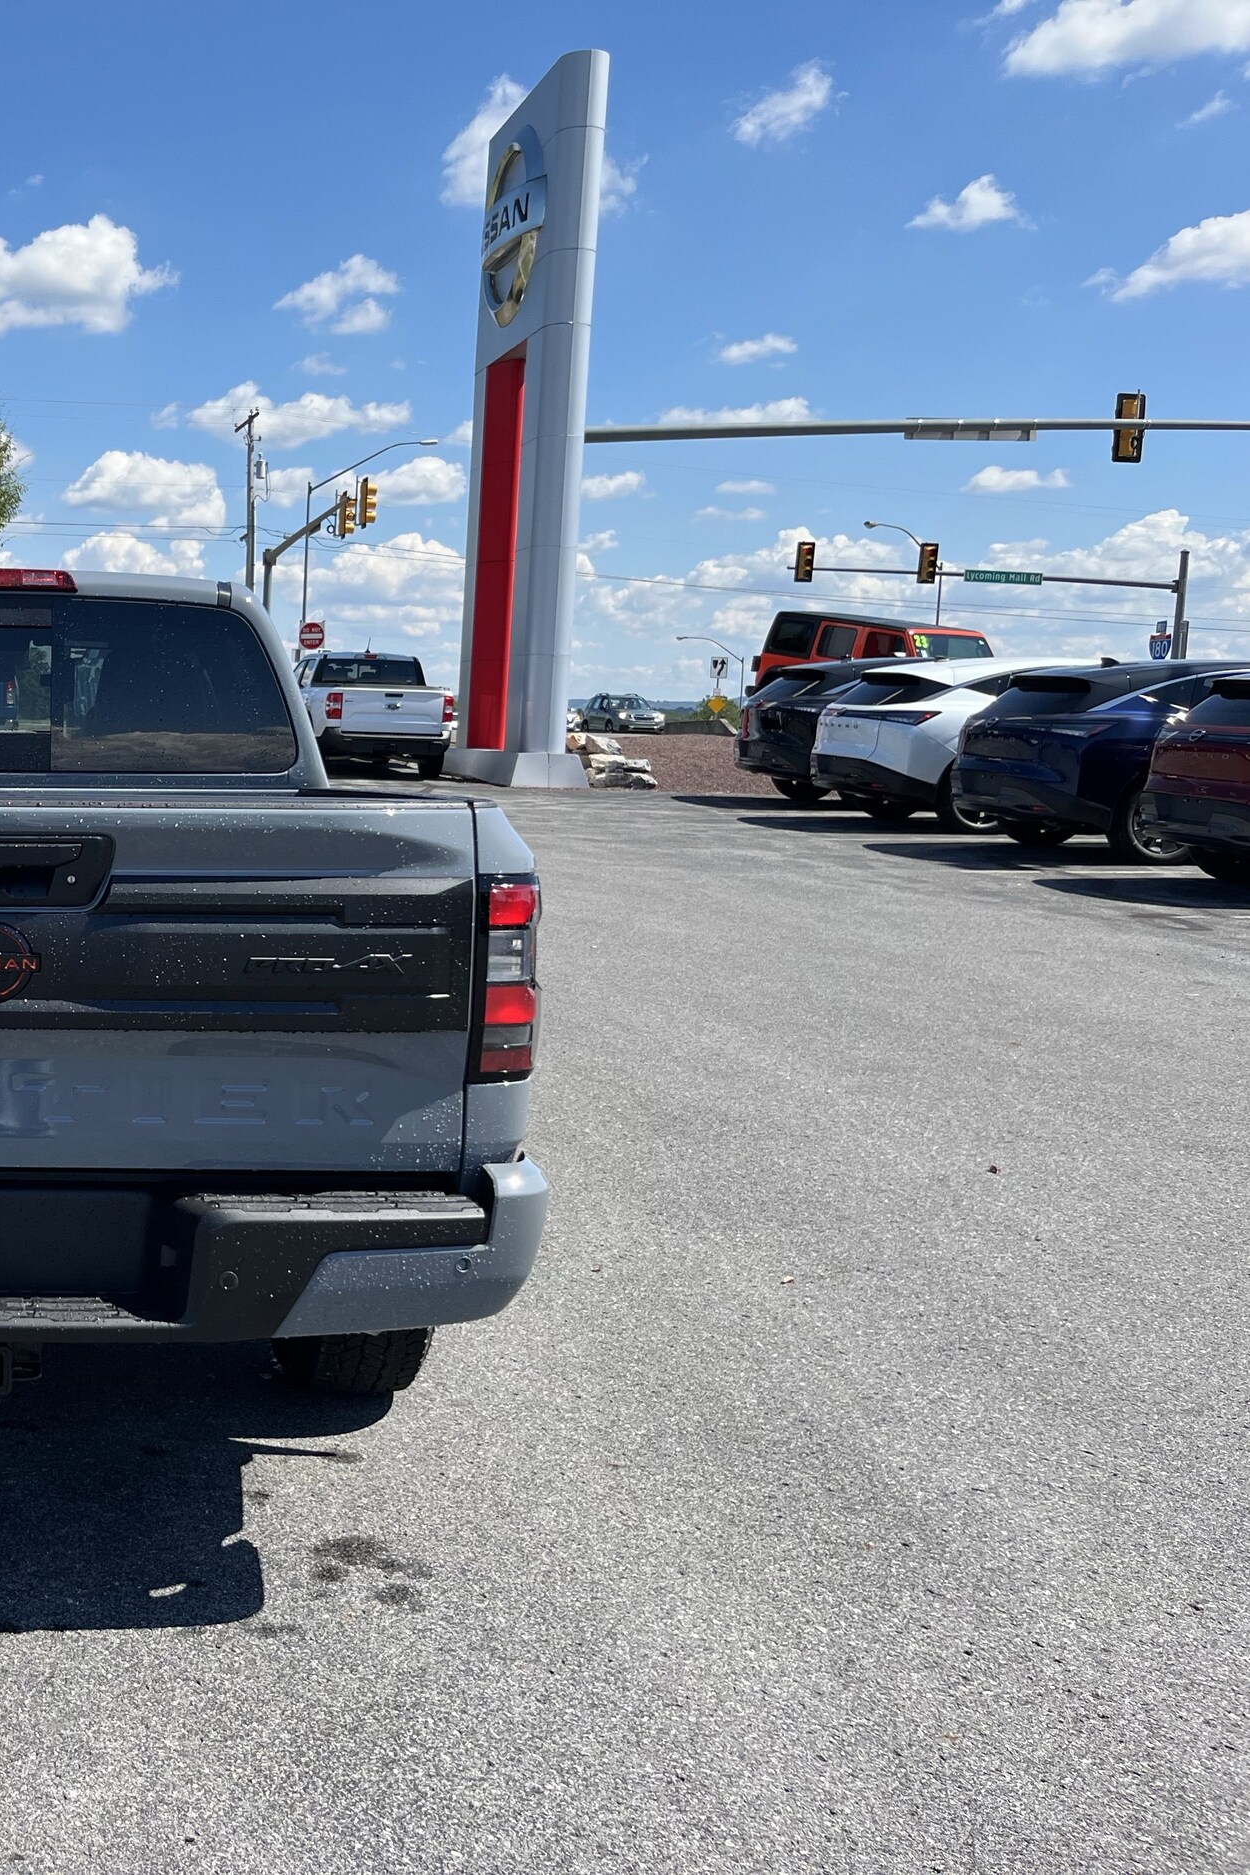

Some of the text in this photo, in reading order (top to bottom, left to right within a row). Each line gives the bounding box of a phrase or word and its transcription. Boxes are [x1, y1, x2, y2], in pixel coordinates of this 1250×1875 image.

[483, 192, 530, 252] SSAN
[966, 571, 1041, 583] Lycoming Mall Rd
[913, 634, 928, 648] 23
[1151, 641, 1168, 657] 180
